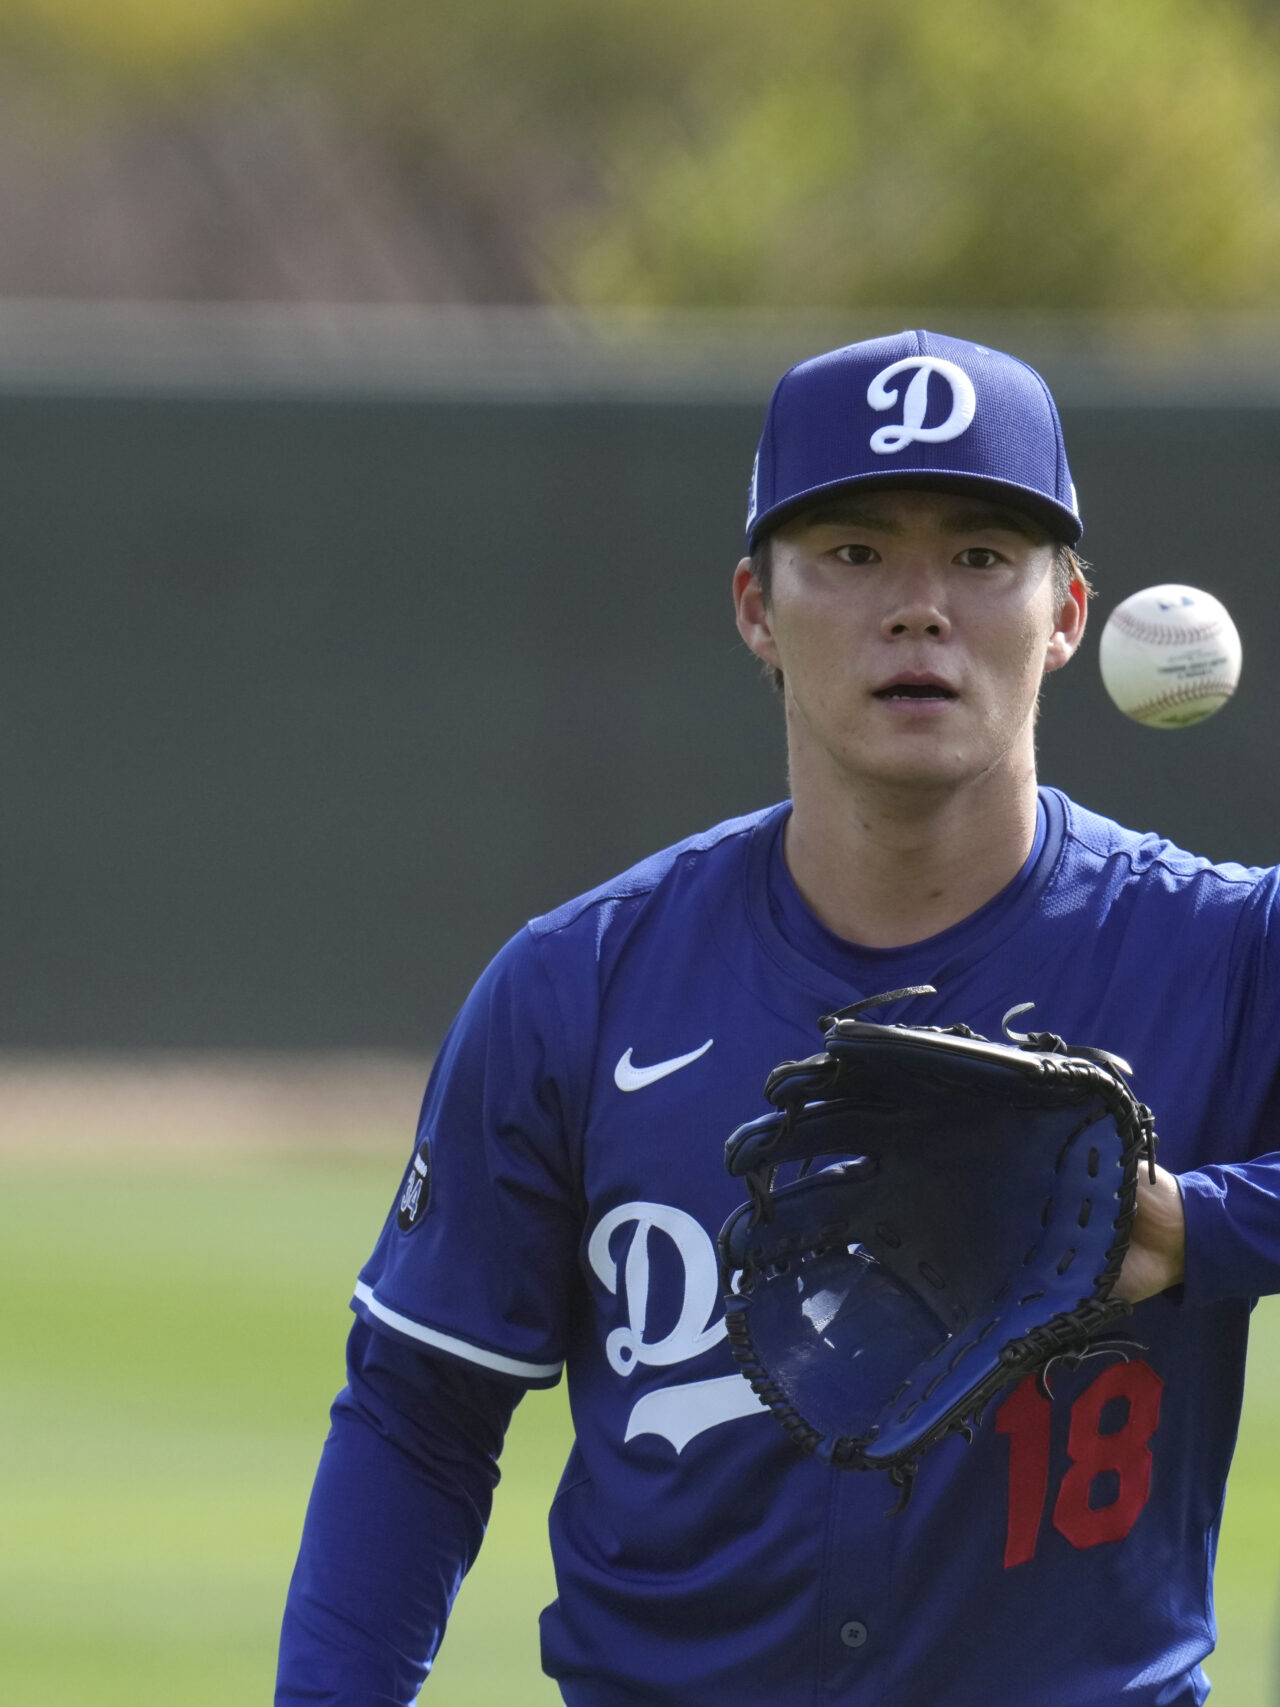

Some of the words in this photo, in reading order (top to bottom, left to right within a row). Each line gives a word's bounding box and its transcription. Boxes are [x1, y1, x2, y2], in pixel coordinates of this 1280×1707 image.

[867, 356, 976, 455] D
[588, 1201, 743, 1377] D
[996, 1361, 1163, 1568] 18
